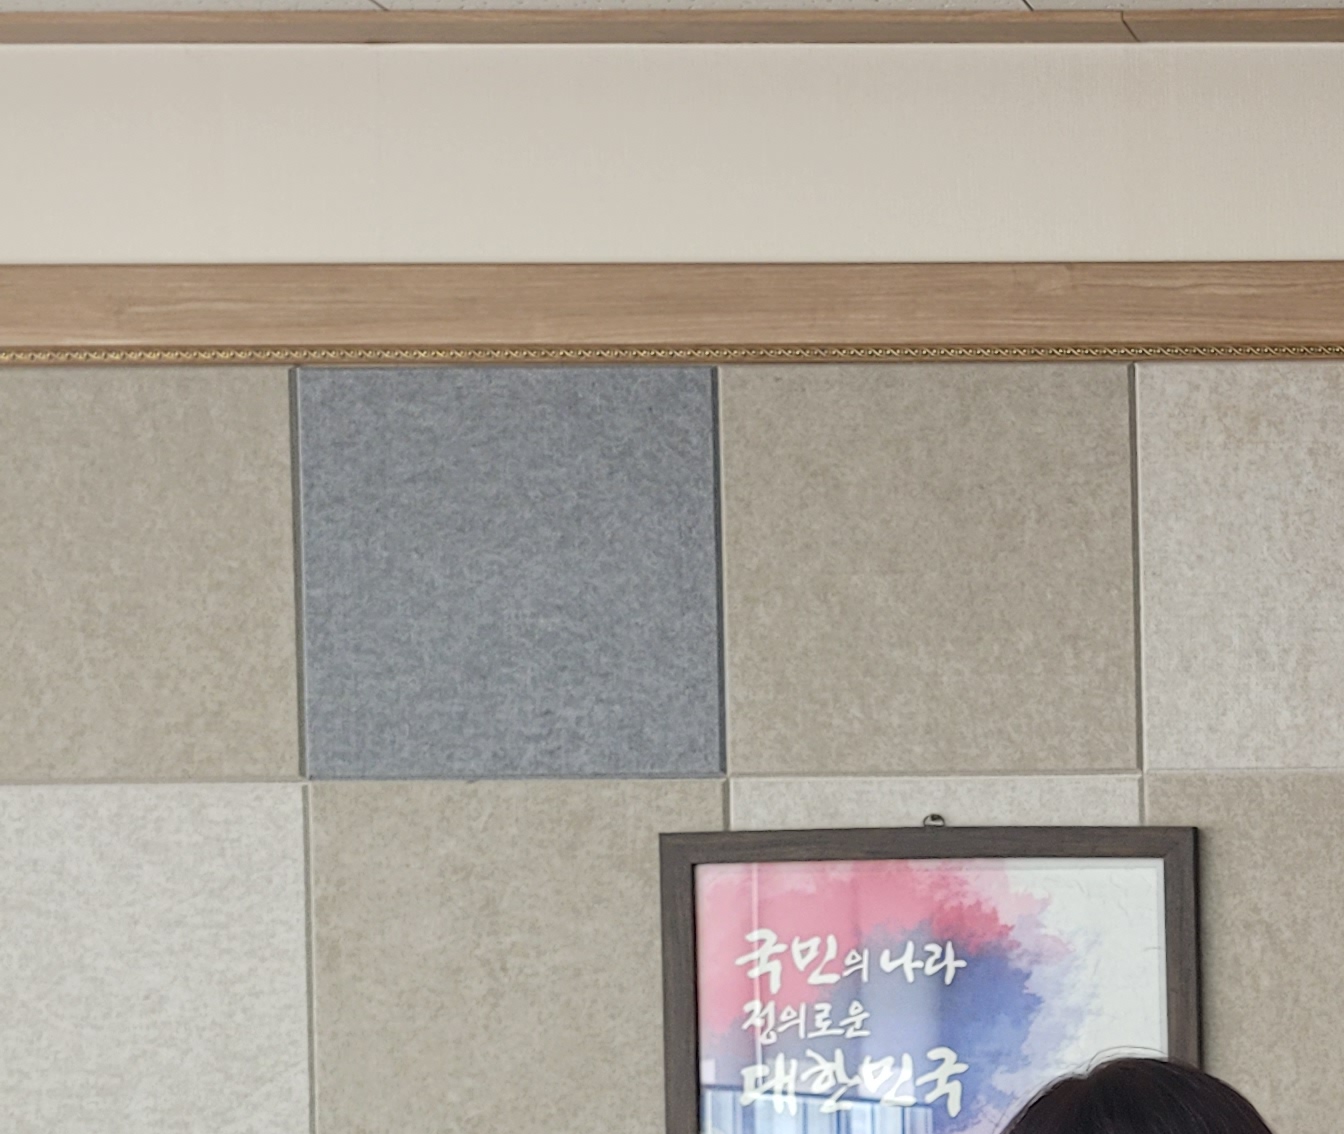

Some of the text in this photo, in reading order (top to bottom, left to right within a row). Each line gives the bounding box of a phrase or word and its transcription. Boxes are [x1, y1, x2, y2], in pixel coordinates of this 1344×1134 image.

[735, 928, 967, 994] 국민의 나라
[742, 1000, 870, 1045] 정의로운
[740, 1047, 969, 1117] 대한민국
